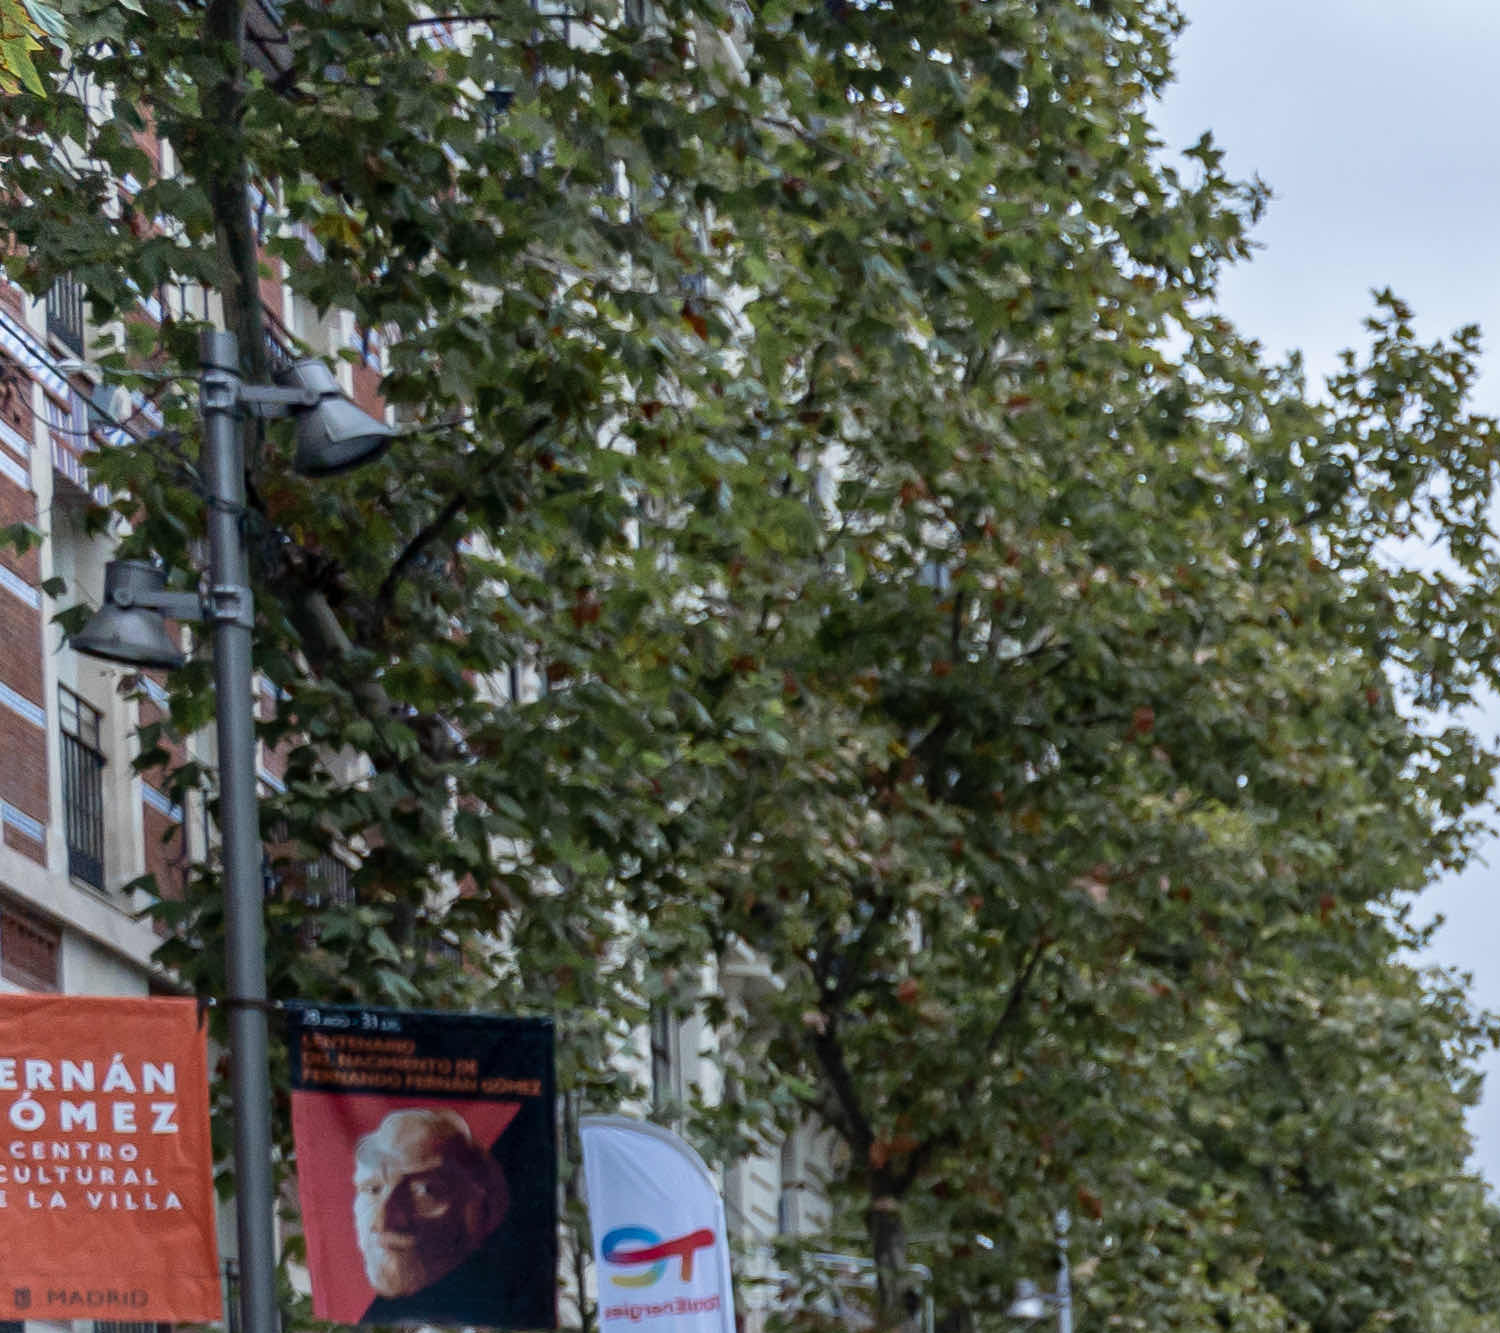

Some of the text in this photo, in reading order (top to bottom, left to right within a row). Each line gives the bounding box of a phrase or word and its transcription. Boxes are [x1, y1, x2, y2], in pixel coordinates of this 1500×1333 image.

[0, 1052, 177, 1094] ERNÁN
[8, 1089, 180, 1134] ÓMEZ
[9, 1140, 139, 1162] CENTRO
[27, 1190, 68, 1209] LA
[86, 1191, 184, 1210] VILLA
[47, 1287, 149, 1308] MADRID
